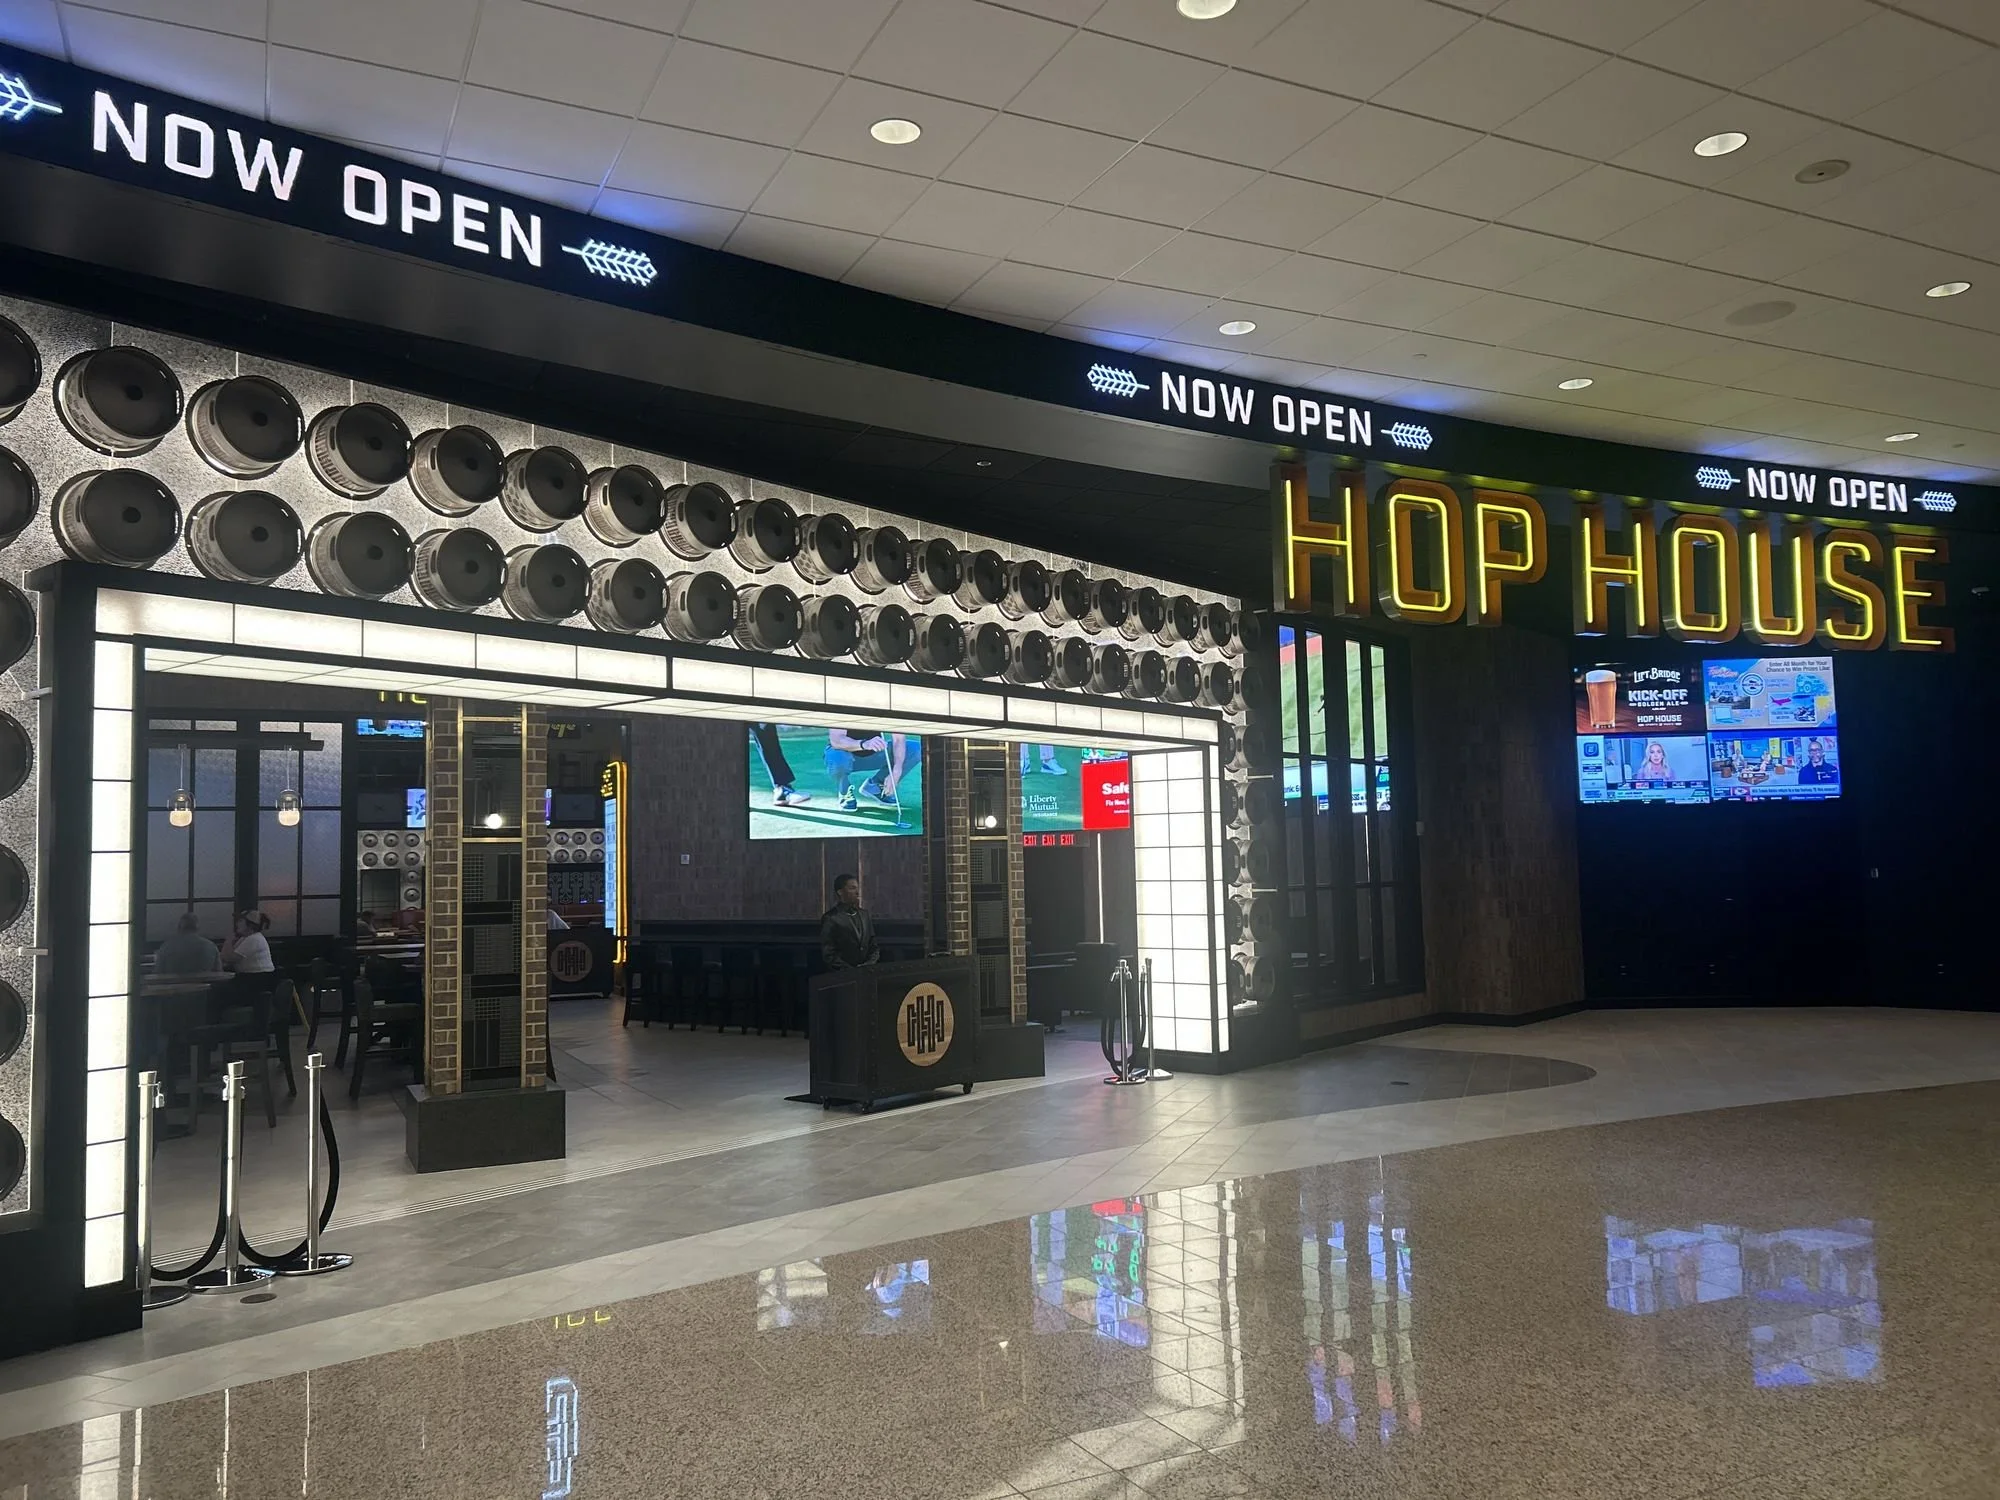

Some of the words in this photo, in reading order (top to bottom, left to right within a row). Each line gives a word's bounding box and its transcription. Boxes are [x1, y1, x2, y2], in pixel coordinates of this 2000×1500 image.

[93, 90, 303, 201] NOW
[343, 164, 542, 268] OPEN
[1161, 371, 1255, 425] NOW
[1272, 394, 1372, 447] OPEN
[1747, 467, 1817, 504] NOW
[1829, 476, 1908, 513] OPEN
[1272, 462, 1547, 626] HOP
[1574, 500, 1956, 652] HOUSE
[1633, 670, 1650, 683] LIFT
[1650, 667, 1681, 683] BRIDGE
[1628, 688, 1688, 702] KICK-OFF
[1637, 715, 1654, 723] HOP
[1655, 714, 1682, 722] HOUSE
[1029, 795, 1057, 803] Liberty
[1023, 835, 1037, 847] EXIT
[1042, 834, 1055, 846] EXIT
[1060, 833, 1074, 846] EXIT
